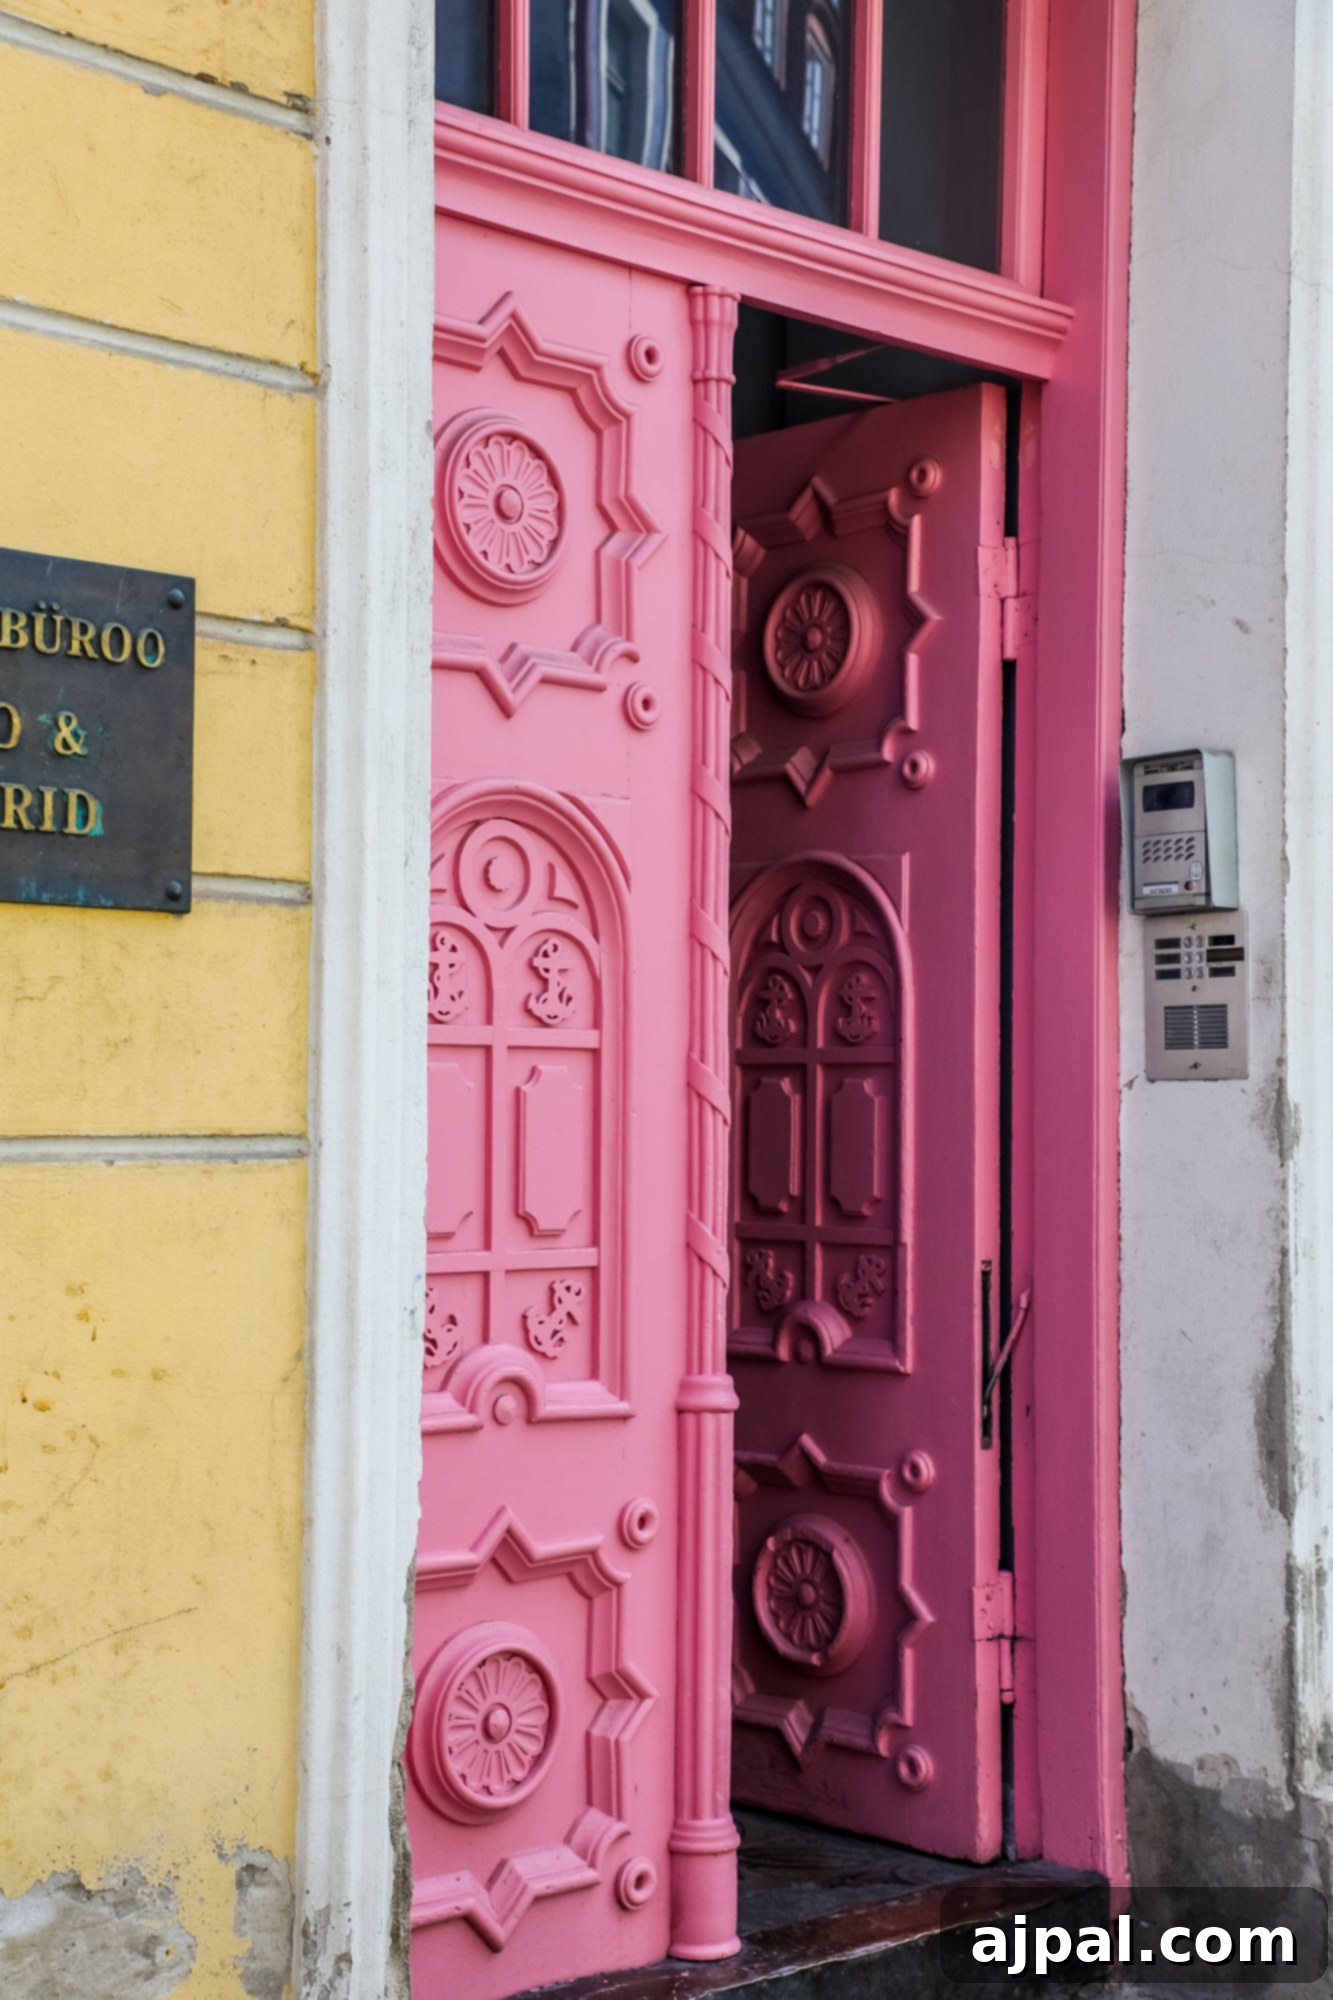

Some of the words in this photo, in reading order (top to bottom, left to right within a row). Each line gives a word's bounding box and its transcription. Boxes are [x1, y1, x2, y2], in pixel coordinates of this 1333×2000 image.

[0, 599, 166, 669] BÜROO
[53, 710, 88, 757] &
[0, 781, 99, 836] RID
